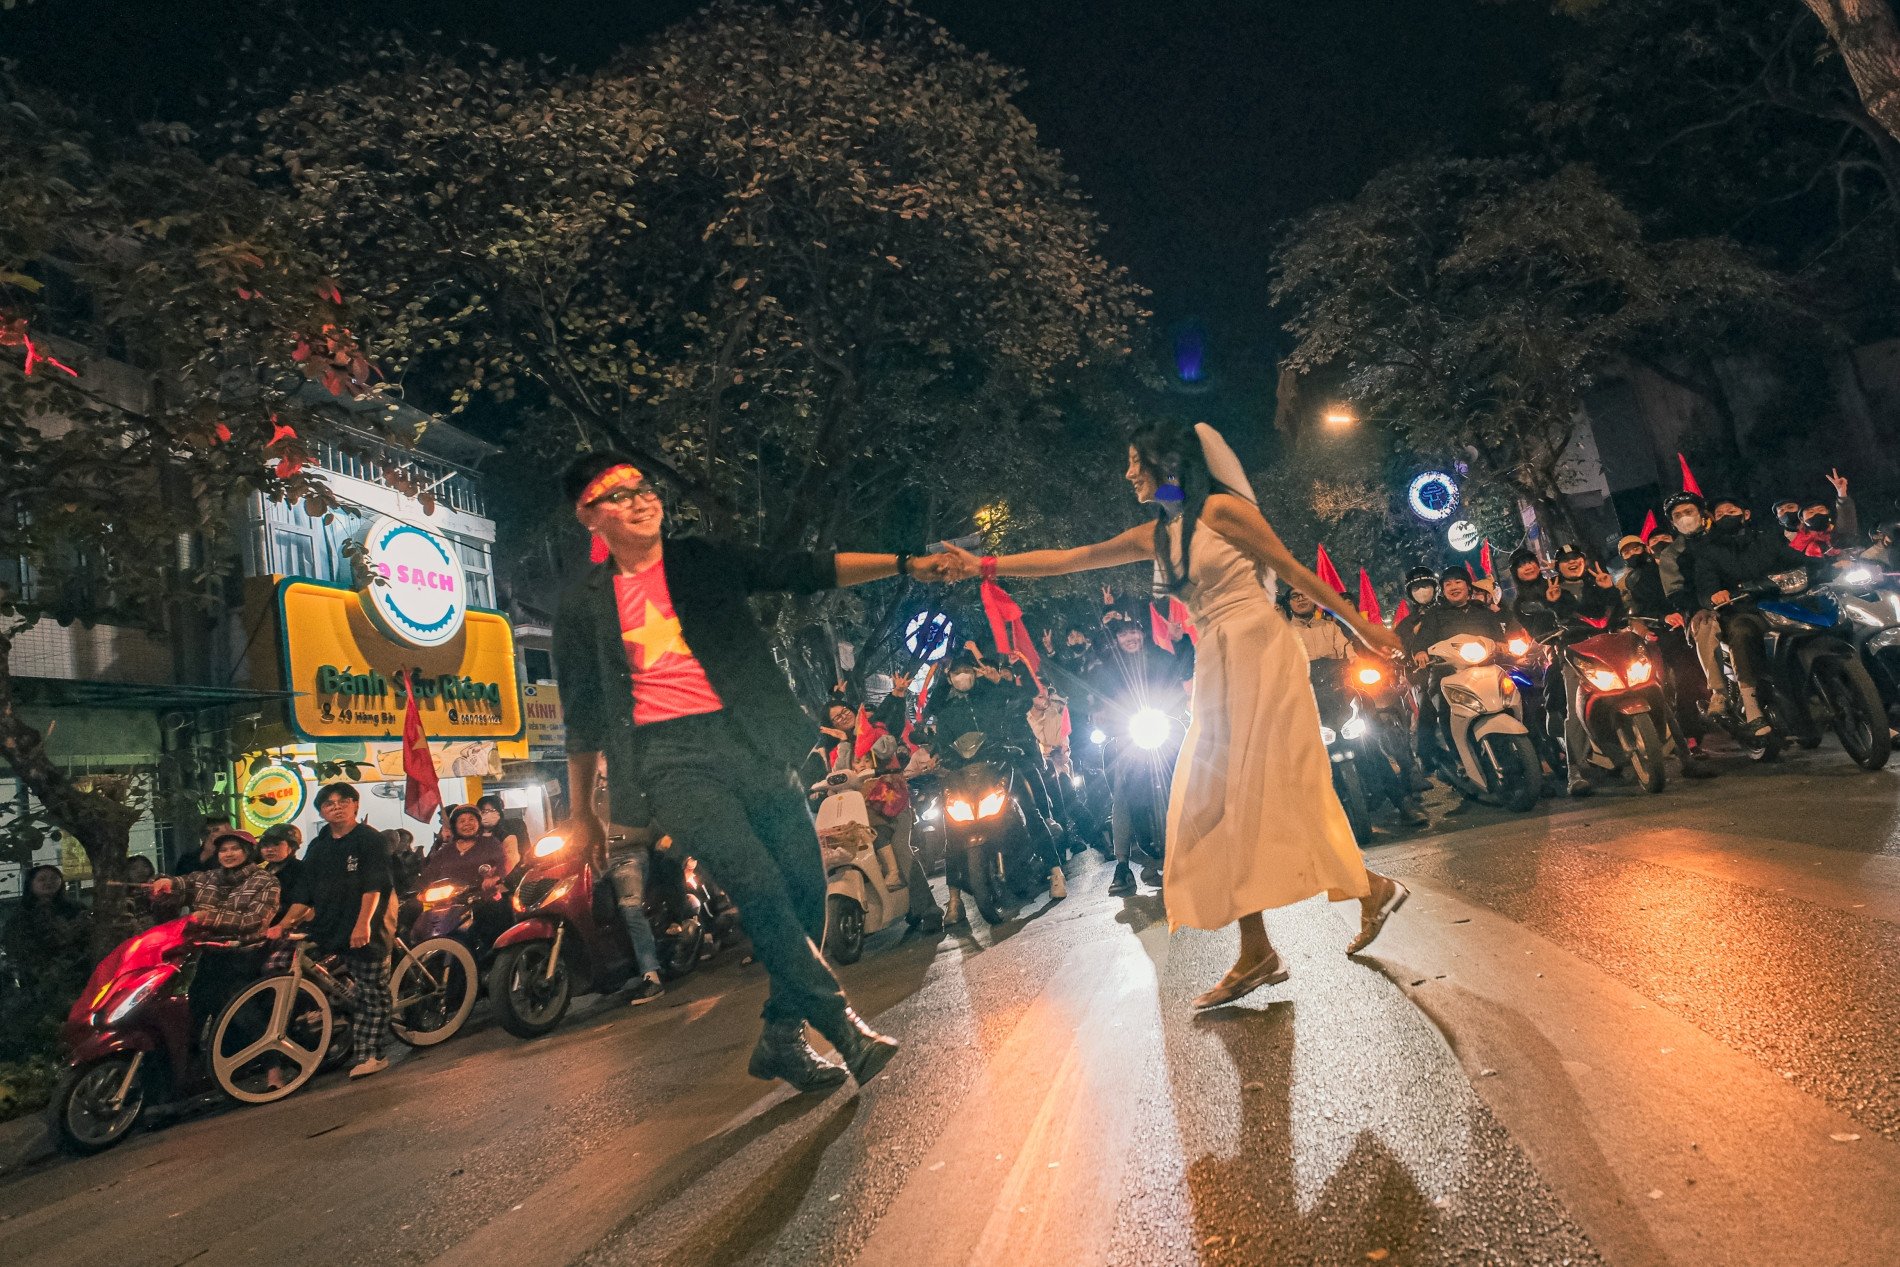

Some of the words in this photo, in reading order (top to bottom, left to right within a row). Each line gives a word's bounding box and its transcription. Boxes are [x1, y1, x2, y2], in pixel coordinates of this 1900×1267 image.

[397, 564, 454, 592] SẠCH
[319, 665, 388, 696] Bánh
[442, 673, 501, 707] Riêng
